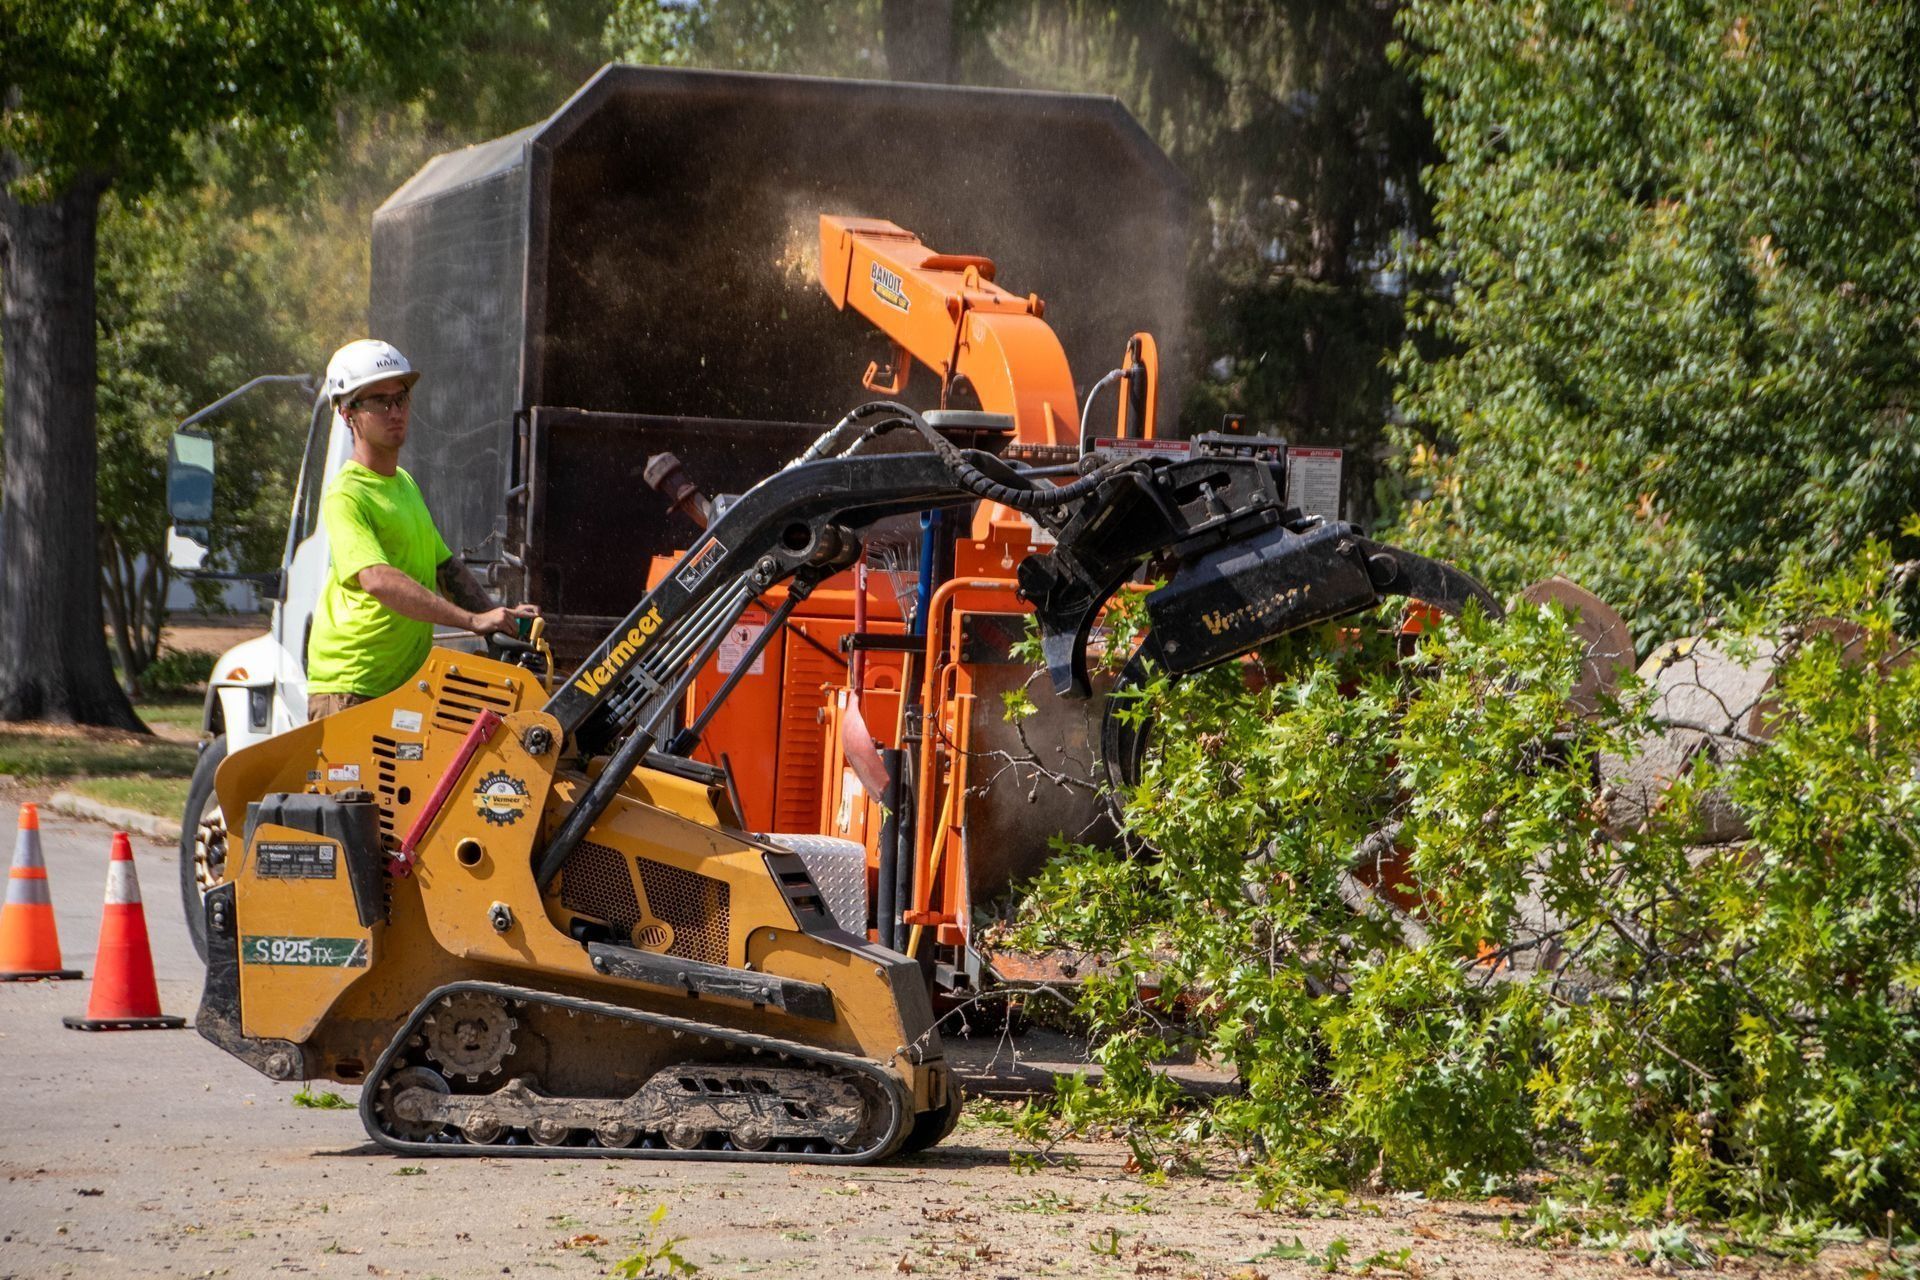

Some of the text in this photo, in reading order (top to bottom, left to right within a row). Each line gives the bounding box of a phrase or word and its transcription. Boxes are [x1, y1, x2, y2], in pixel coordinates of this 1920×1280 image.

[871, 262, 902, 294] BANDIT
[574, 606, 663, 697] Vermeer
[493, 795, 520, 803] Vermeer
